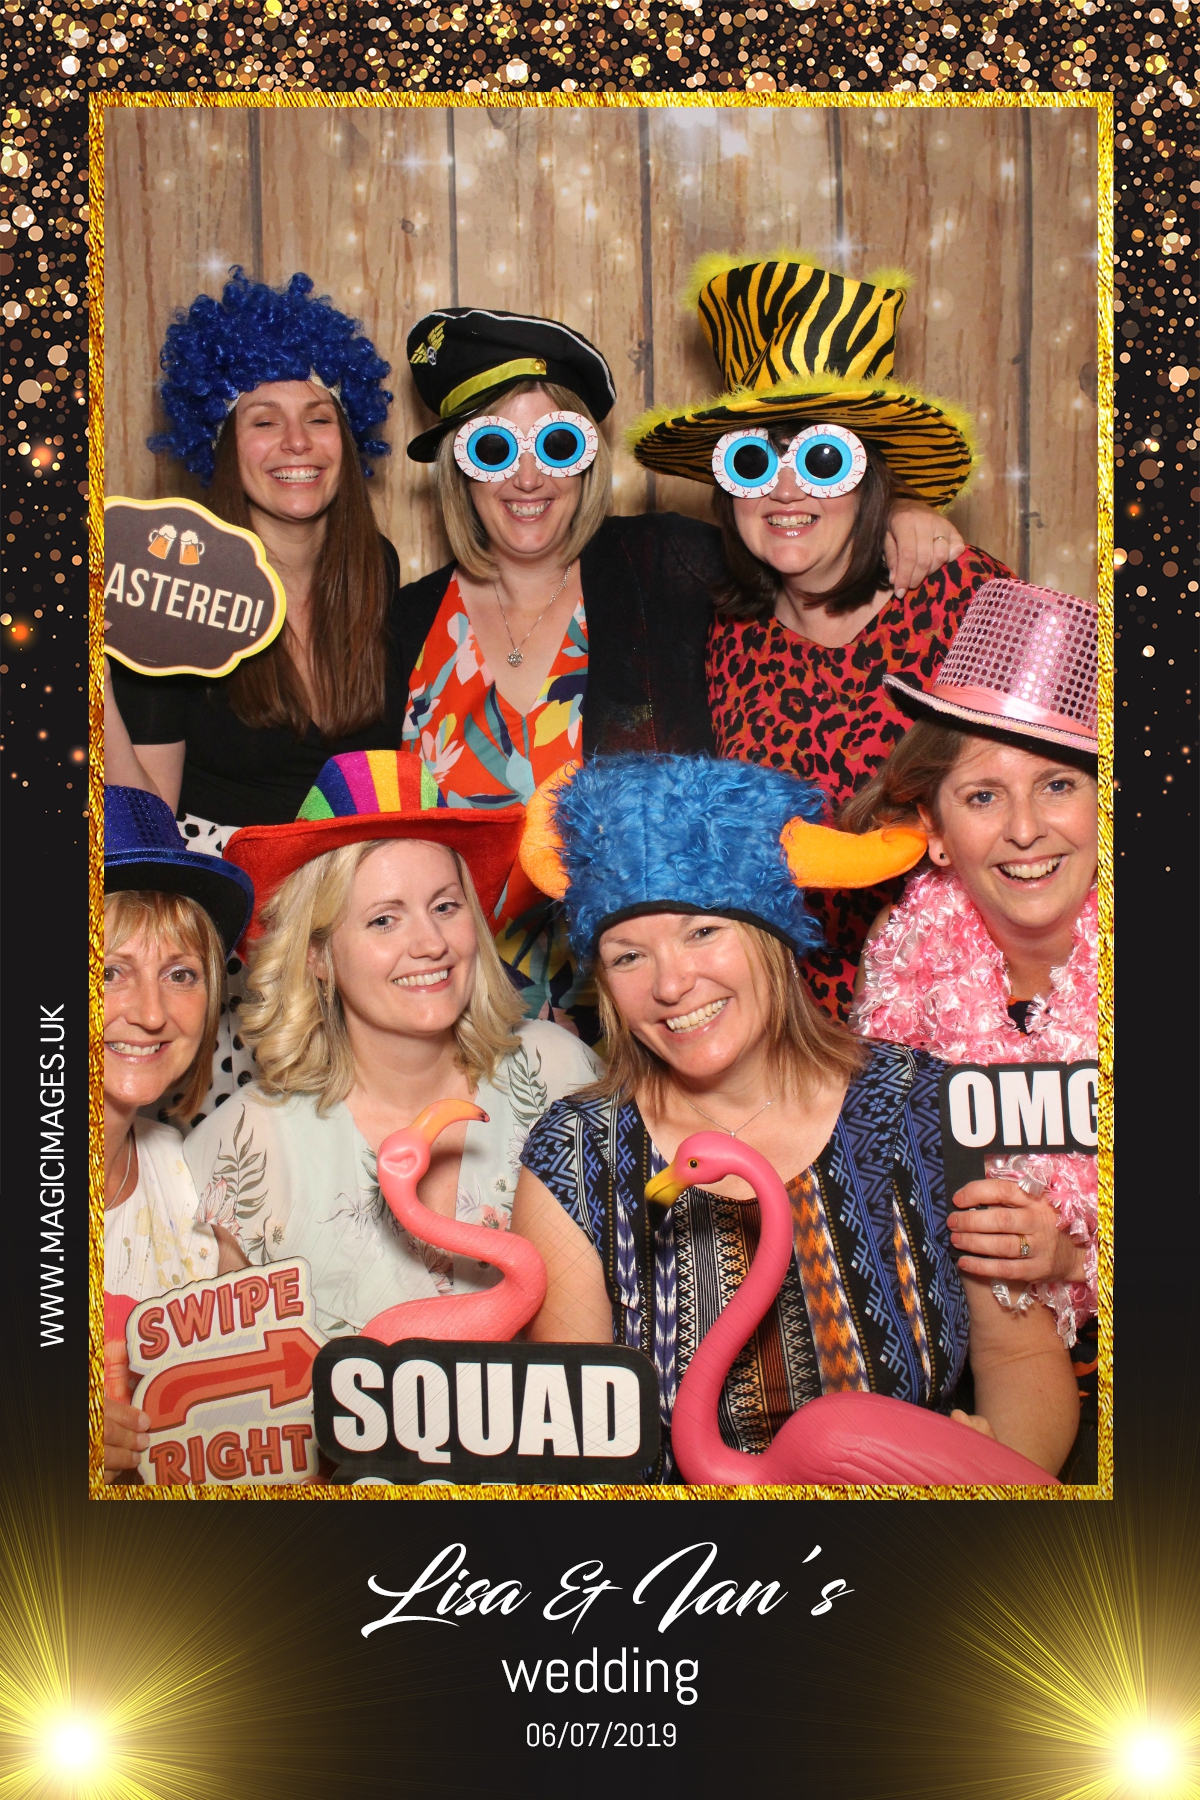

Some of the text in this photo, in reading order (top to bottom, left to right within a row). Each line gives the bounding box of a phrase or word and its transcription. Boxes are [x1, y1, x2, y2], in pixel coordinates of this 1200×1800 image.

[104, 562, 265, 638] ASTERED!
[137, 1267, 304, 1361] SWIPE
[331, 1357, 641, 1464] SQUAD
[149, 1424, 313, 1486] RIGHT
